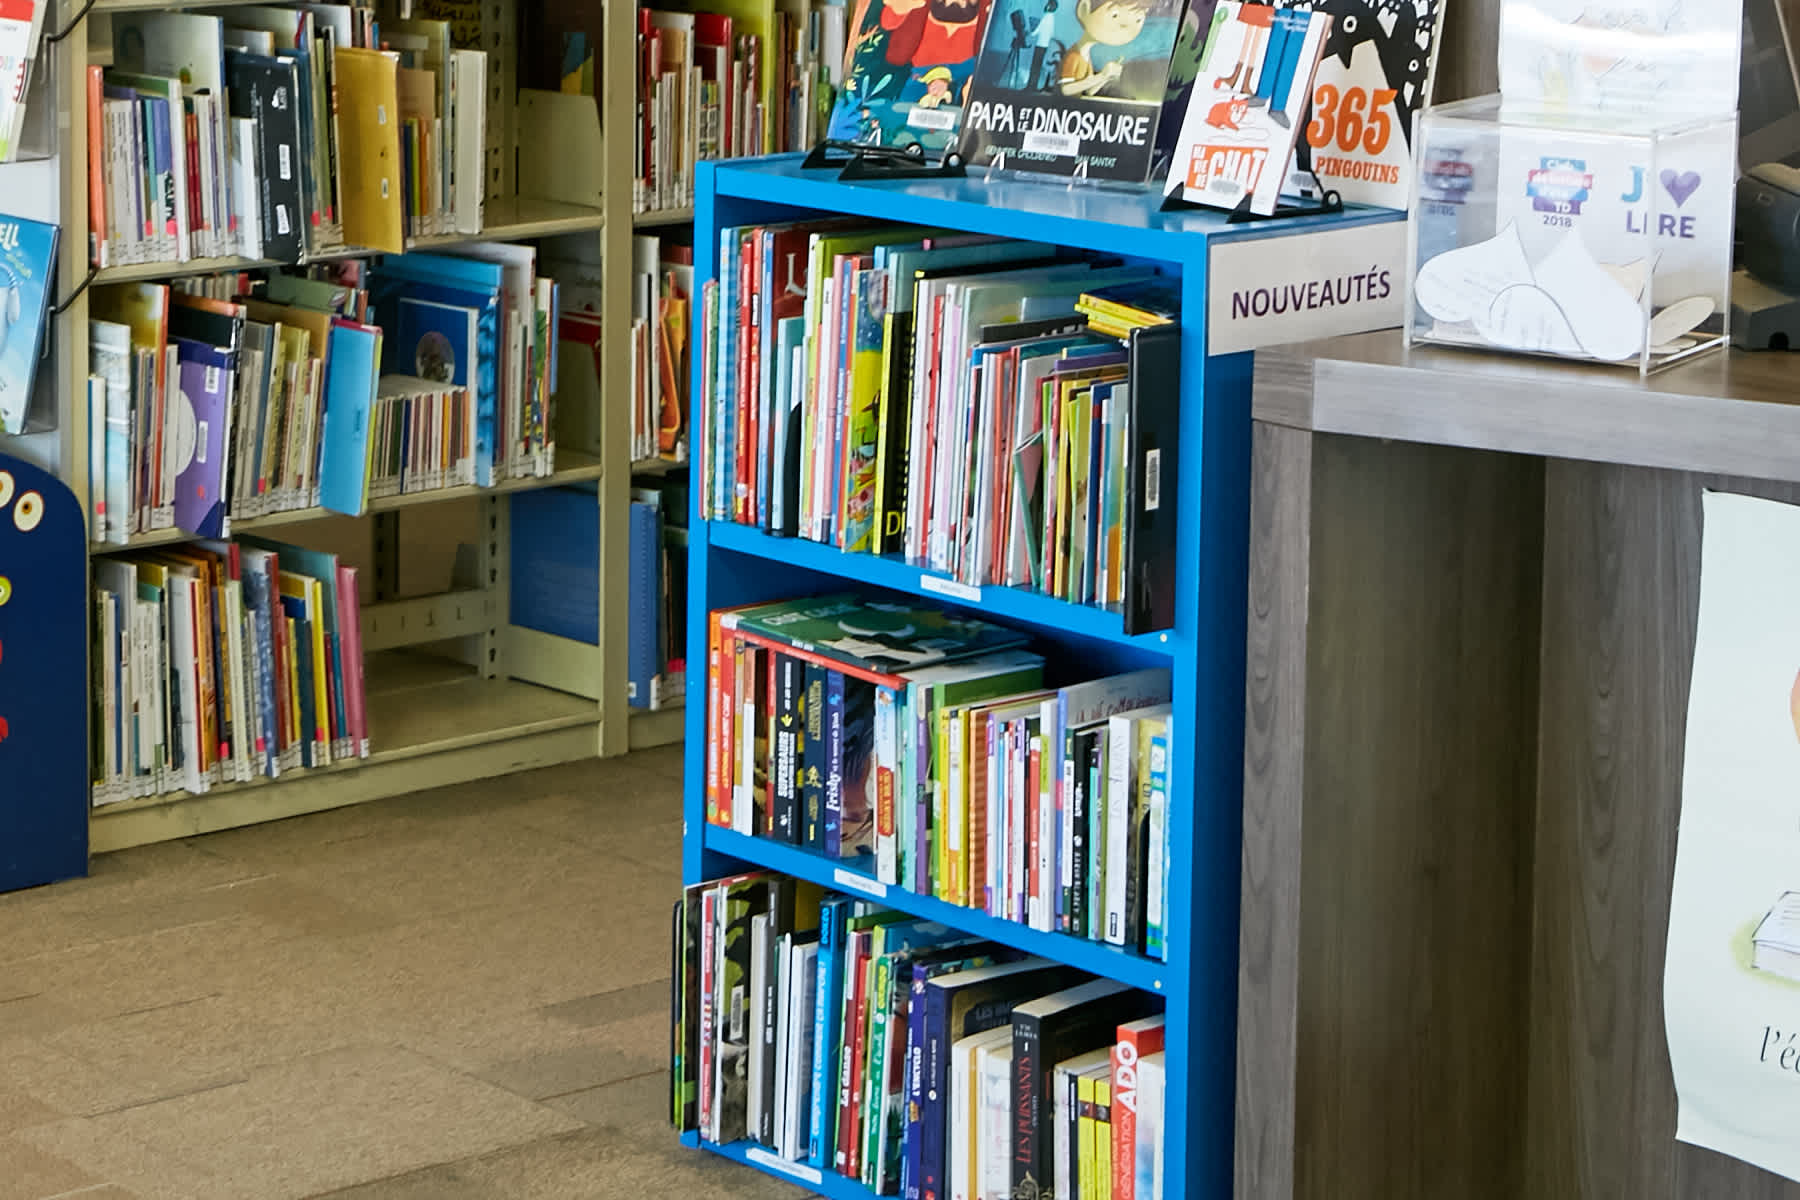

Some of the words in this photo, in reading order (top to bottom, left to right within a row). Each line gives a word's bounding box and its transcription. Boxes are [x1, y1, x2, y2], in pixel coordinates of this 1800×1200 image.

[967, 101, 1014, 133] PAPA
[1019, 108, 1032, 119] ET
[1032, 107, 1150, 145] DINOSAURE
[1306, 84, 1398, 156] 365
[1208, 149, 1266, 193] CHAT
[1315, 156, 1399, 184] PINGOUINS
[1544, 215, 1572, 227] 2018
[1555, 203, 1571, 213] TD
[1626, 211, 1696, 238] LIRE
[1232, 266, 1391, 319] NOUVEAUTÉS
[1116, 1040, 1137, 1112] ADO
[1017, 1057, 1032, 1135] PUISSANTS
